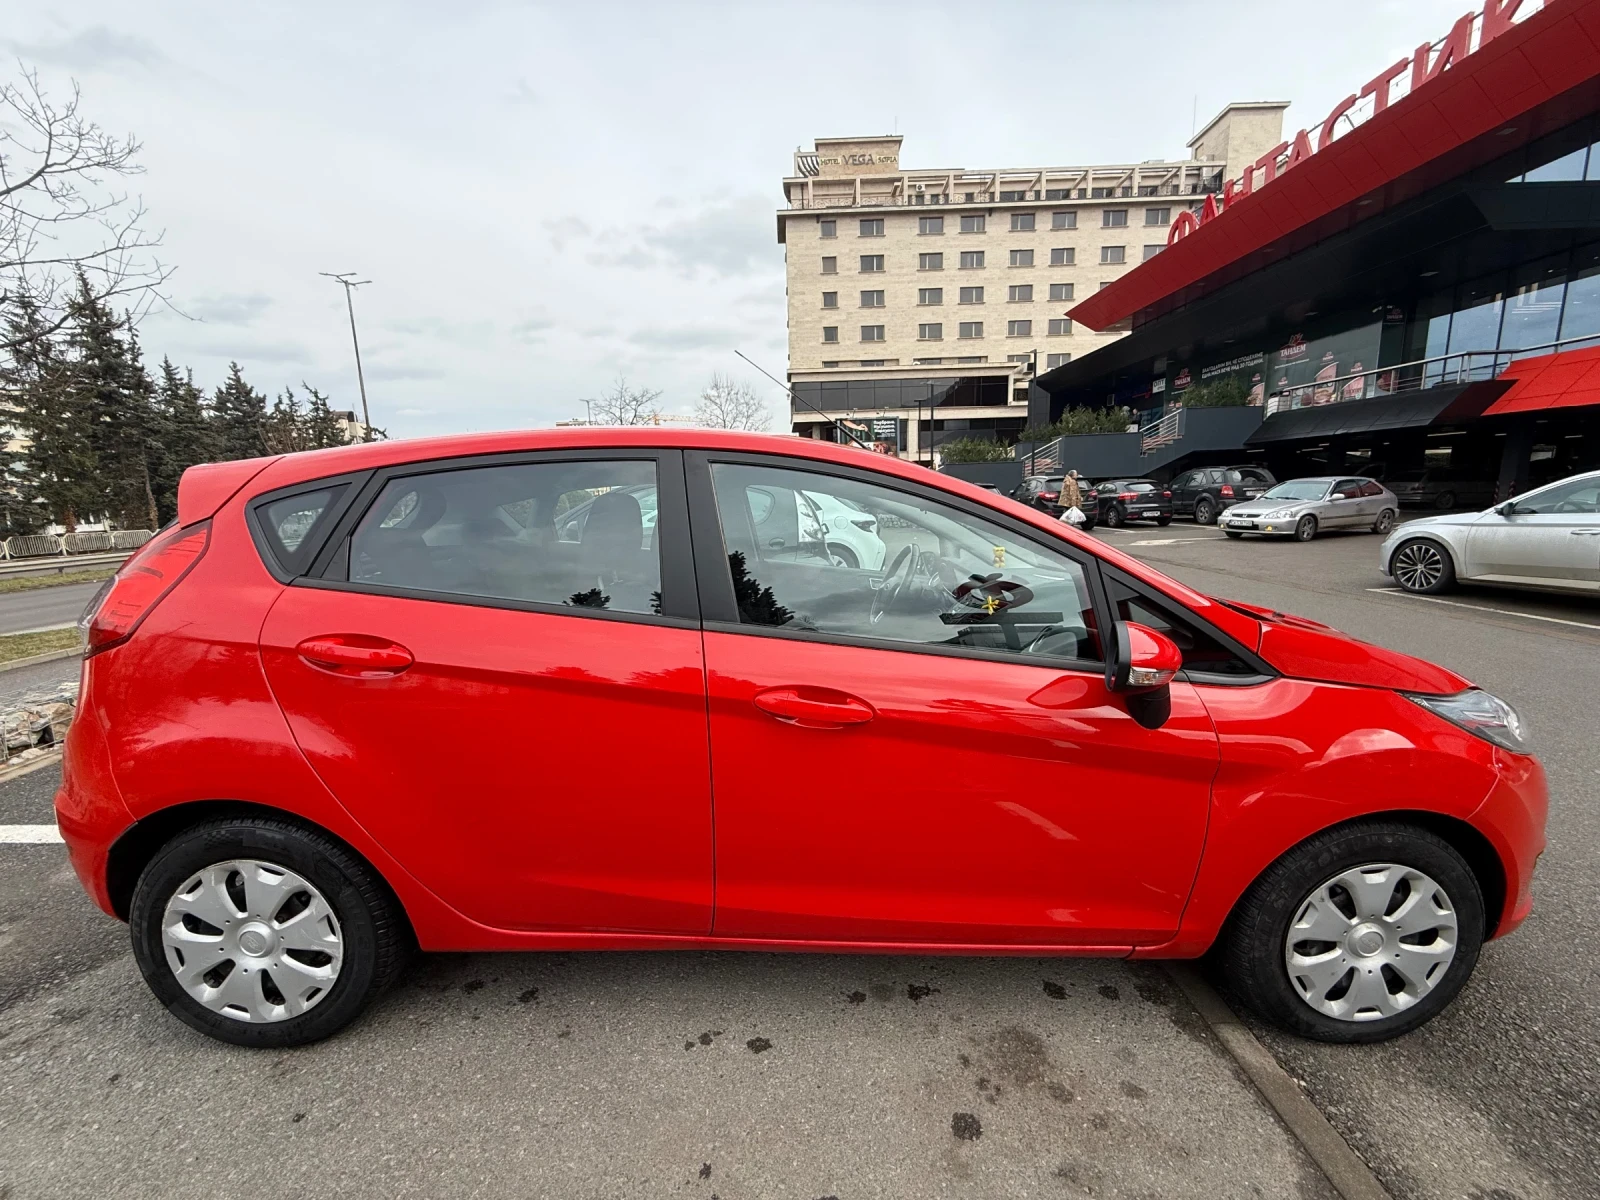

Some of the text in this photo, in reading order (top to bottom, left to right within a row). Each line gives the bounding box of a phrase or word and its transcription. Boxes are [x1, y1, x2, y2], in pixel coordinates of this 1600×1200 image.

[1167, 0, 1555, 247] ФАНТАСТИК
[820, 154, 898, 166] HOTEL VEGA SOFIA
[1280, 343, 1306, 357] ТАНДЕМ
